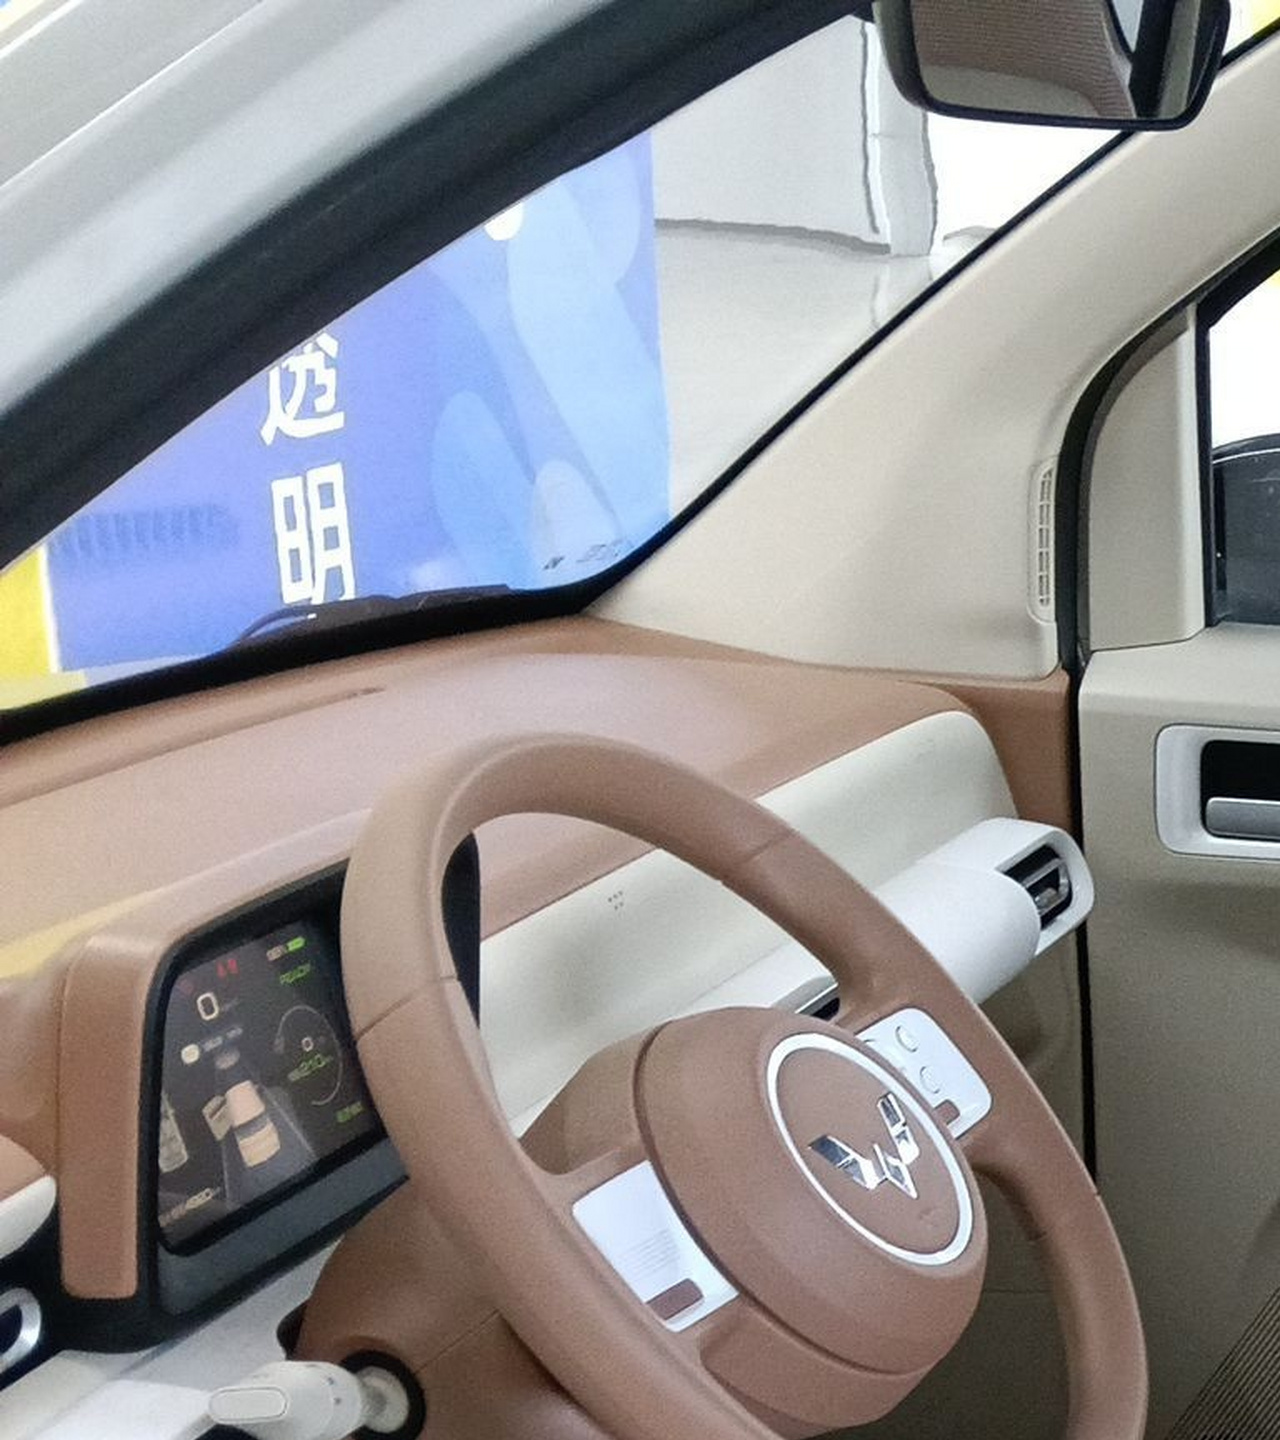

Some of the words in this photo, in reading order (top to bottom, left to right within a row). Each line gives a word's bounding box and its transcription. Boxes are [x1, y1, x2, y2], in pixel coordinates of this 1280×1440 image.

[261, 332, 356, 605] 透明
[197, 992, 219, 1021] 0
[302, 1037, 314, 1052] 0
